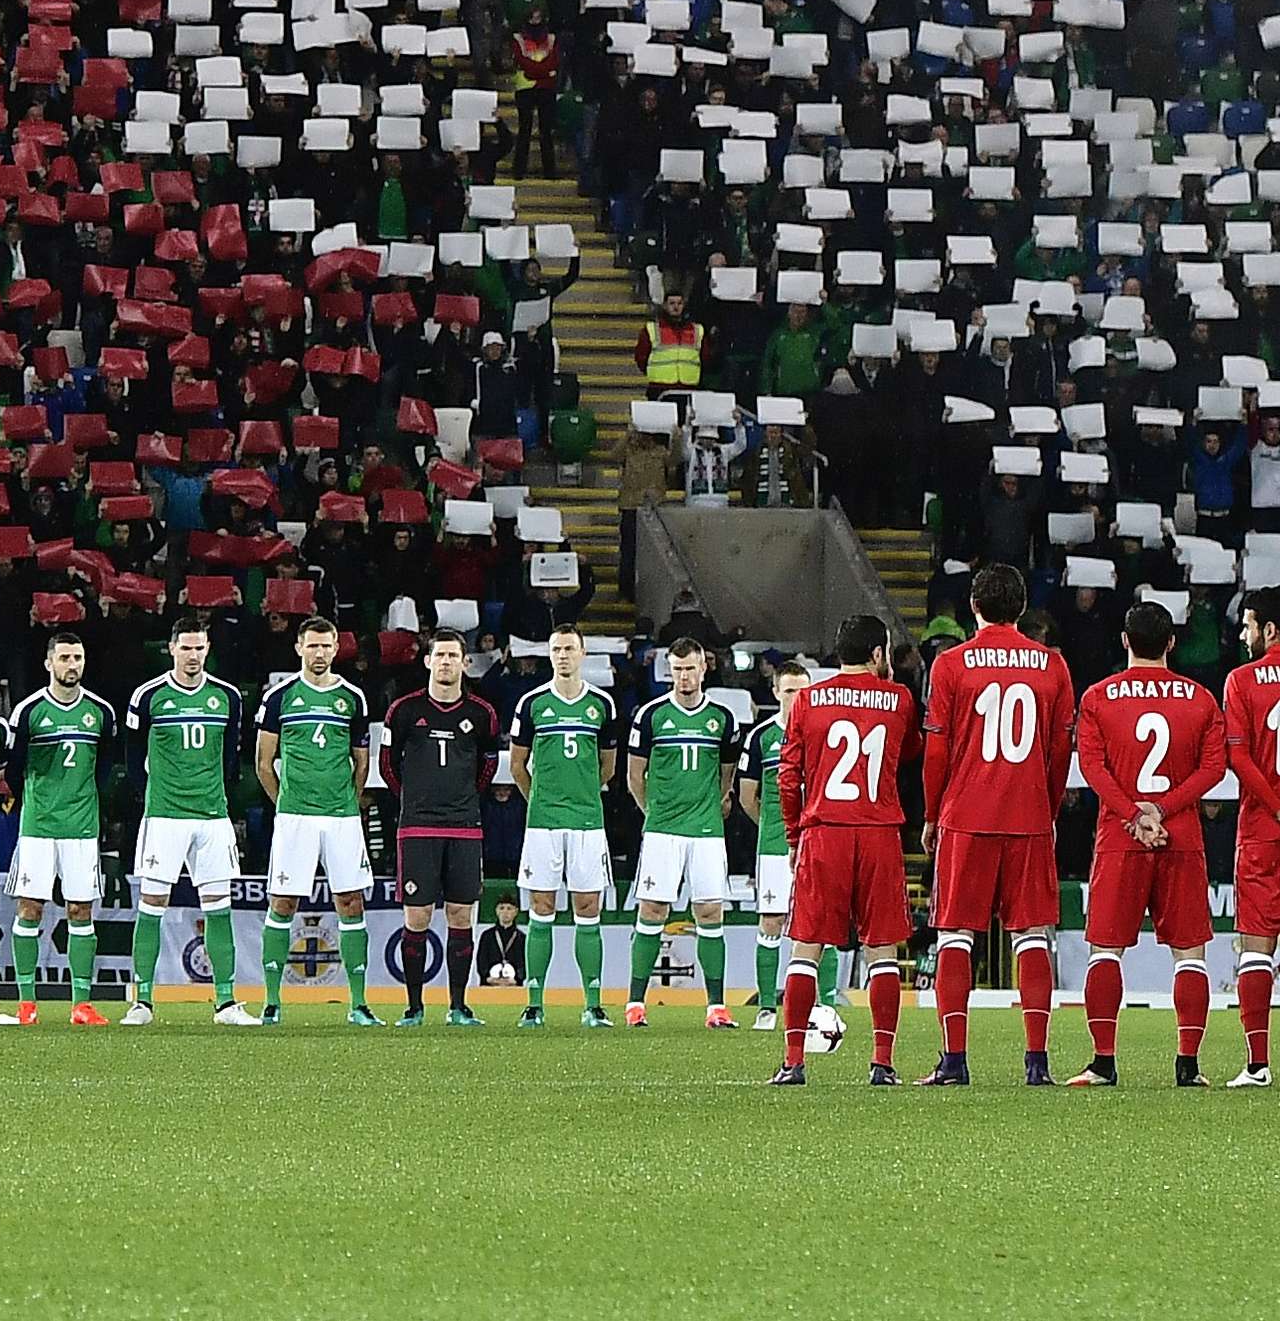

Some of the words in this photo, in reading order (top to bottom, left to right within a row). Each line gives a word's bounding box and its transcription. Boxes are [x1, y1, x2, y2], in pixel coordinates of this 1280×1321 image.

[963, 647, 1049, 671] GURBANOV
[810, 686, 899, 712] DASHDEMIROV
[1106, 680, 1195, 700] GARAYEV
[178, 722, 209, 750] 10
[312, 721, 329, 749] 4
[974, 682, 1037, 763] 10
[61, 741, 78, 767] 2
[437, 739, 447, 767] 1
[559, 731, 581, 759] 5
[680, 744, 703, 771] 11
[1135, 712, 1171, 793] 2
[824, 720, 887, 803] 21
